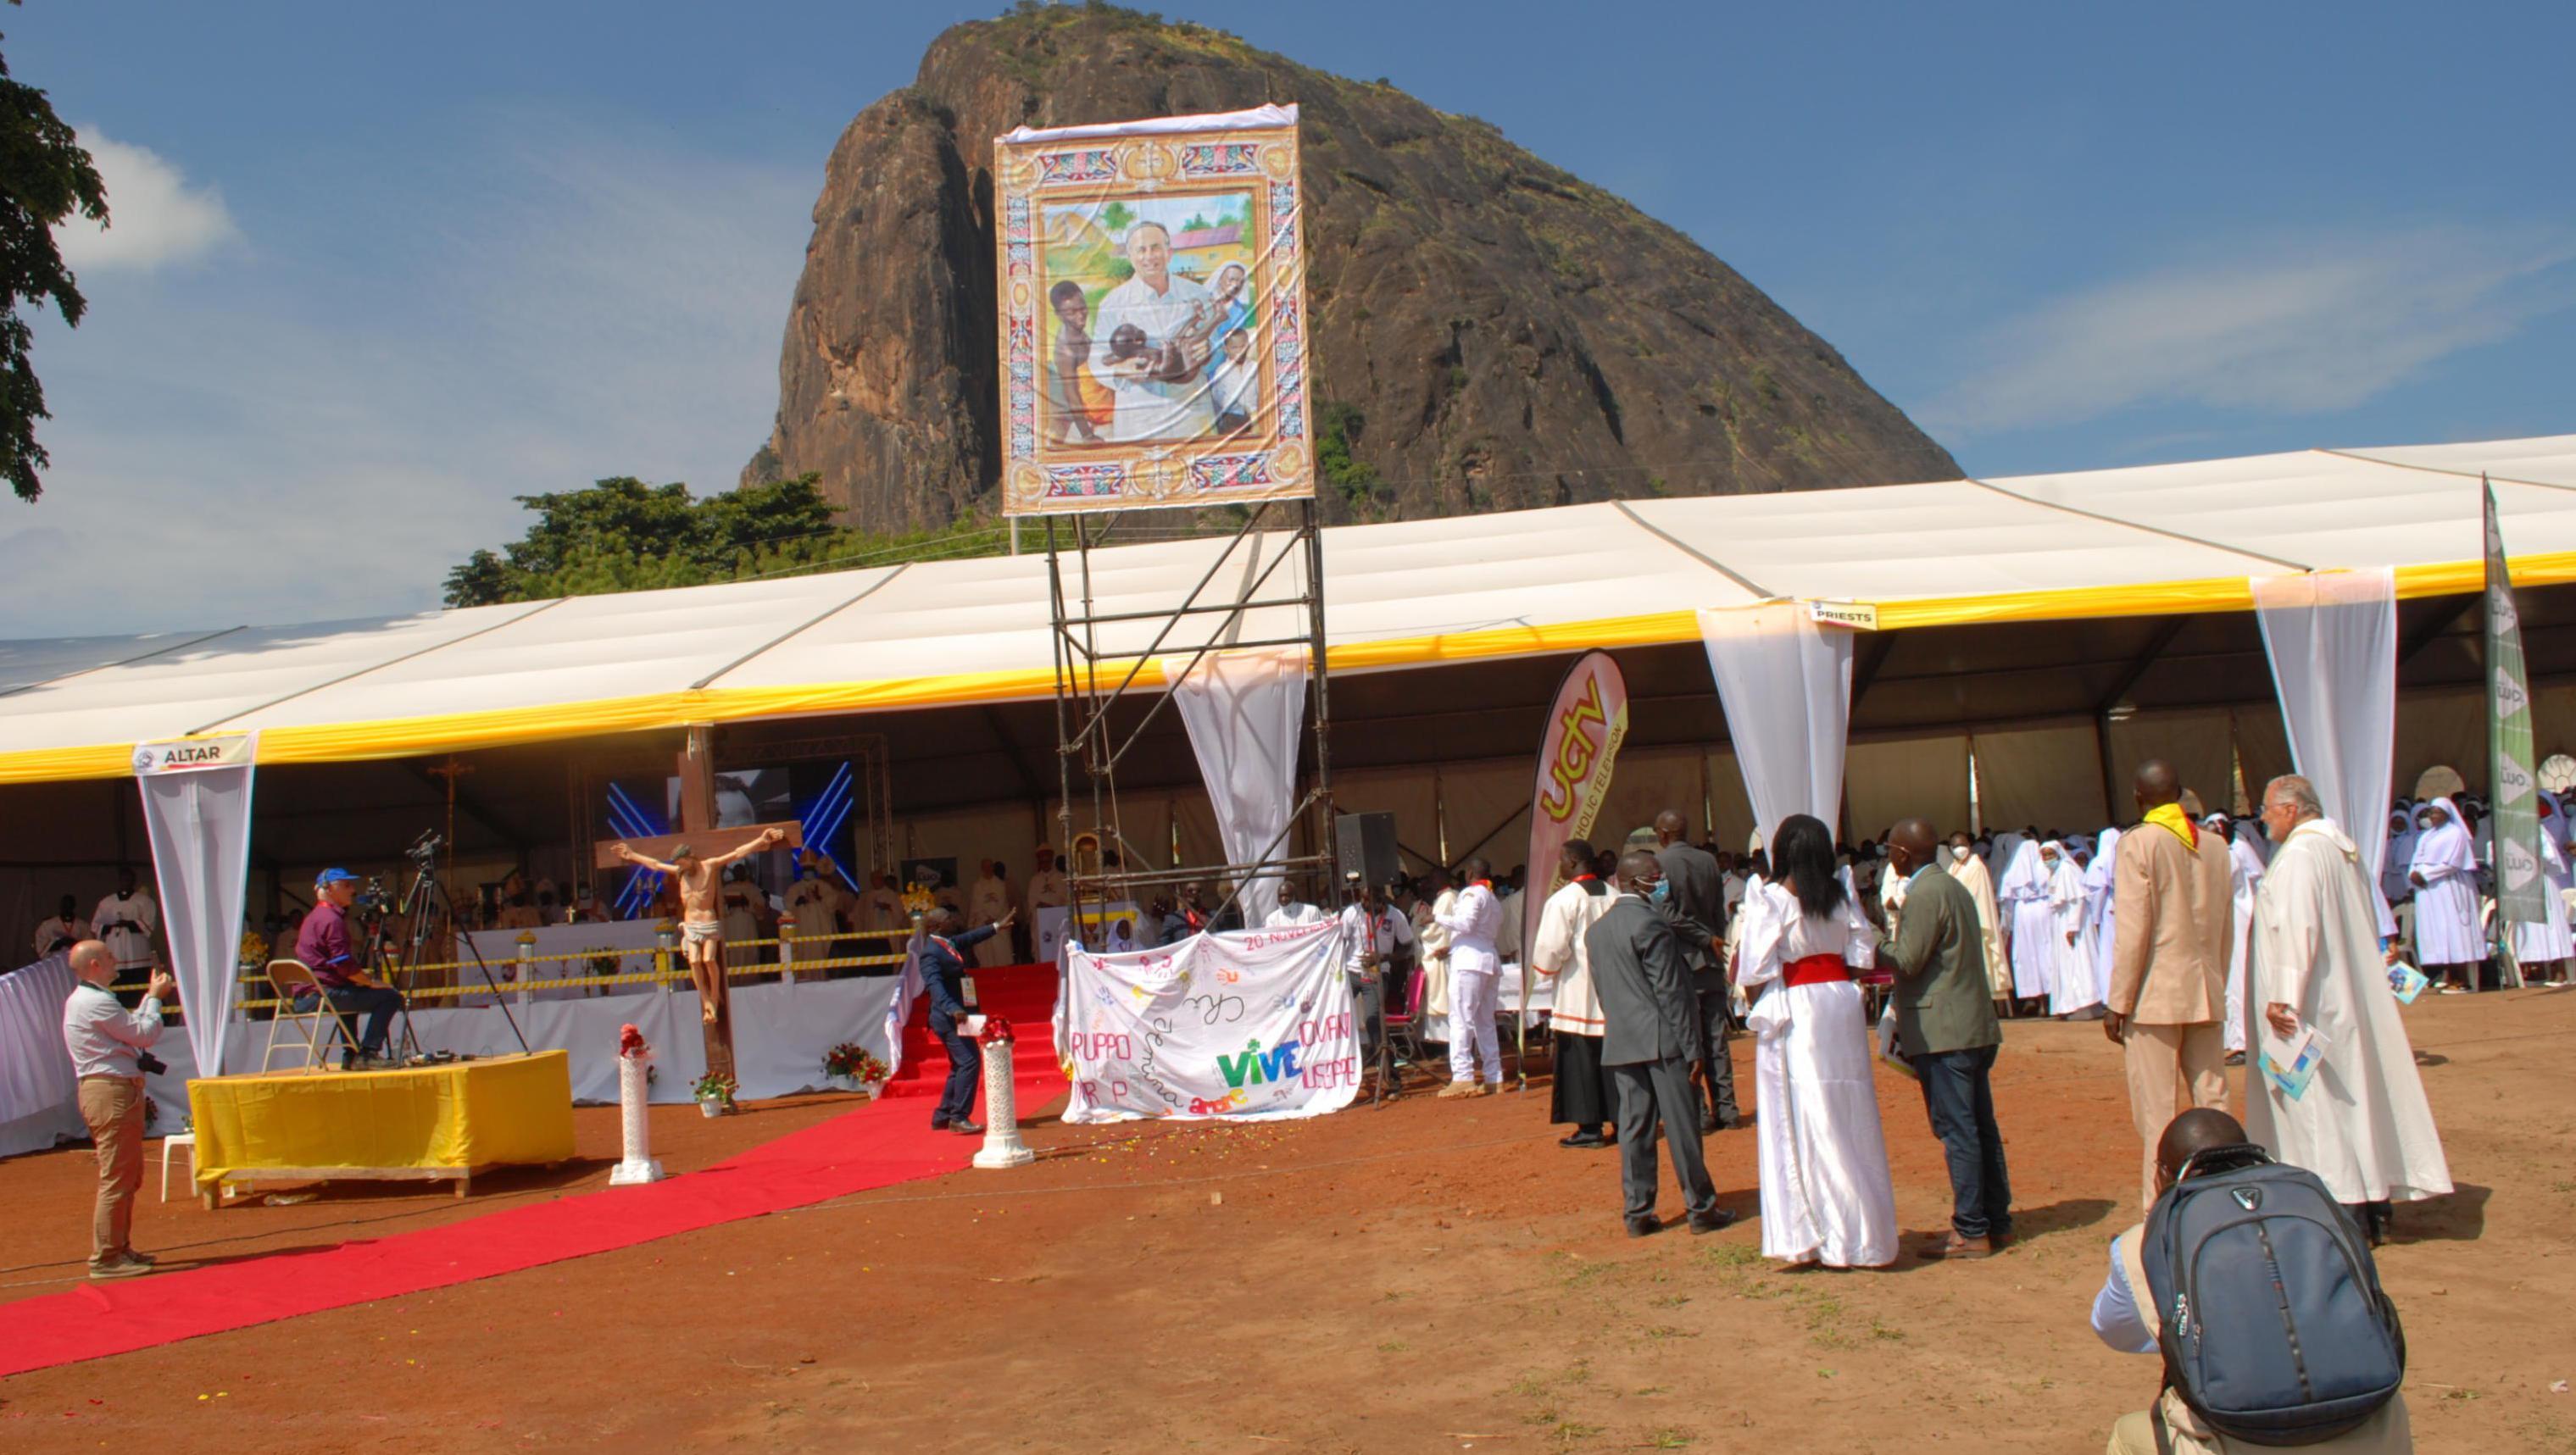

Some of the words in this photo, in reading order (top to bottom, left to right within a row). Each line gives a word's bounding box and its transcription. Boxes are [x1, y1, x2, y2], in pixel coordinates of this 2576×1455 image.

[1817, 610, 1872, 622] PRIESTS
[164, 746, 220, 764] ALTAR
[1244, 935, 1264, 952] 20
